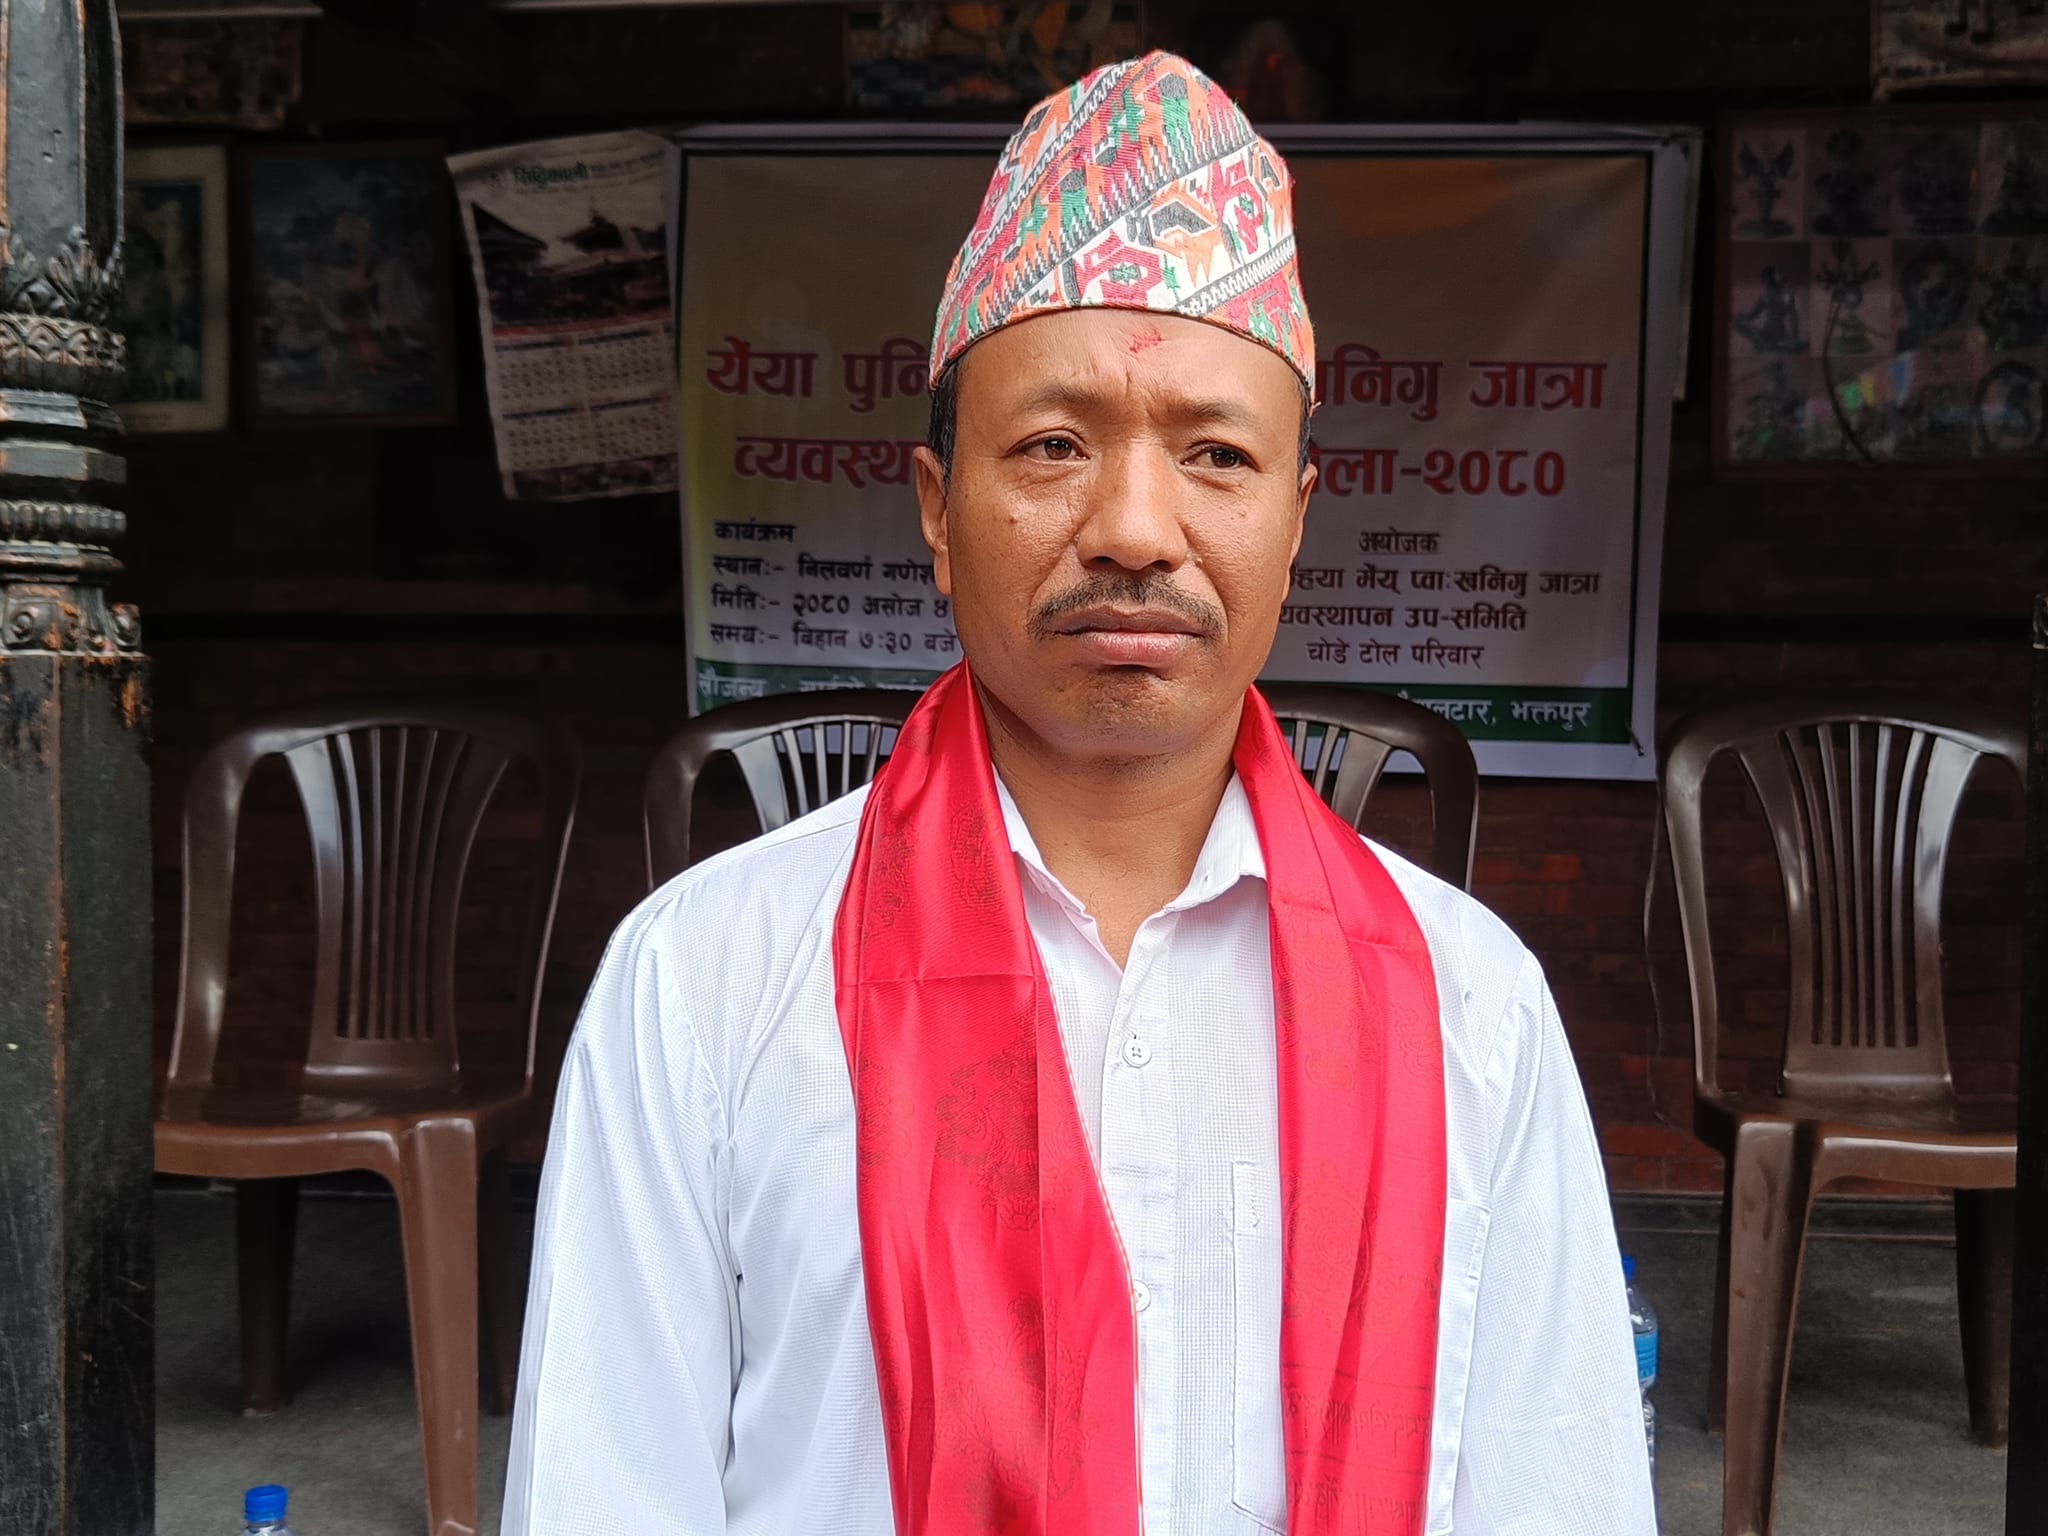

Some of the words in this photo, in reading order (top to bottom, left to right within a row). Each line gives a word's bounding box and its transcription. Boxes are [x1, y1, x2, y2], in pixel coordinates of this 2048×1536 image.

[1470, 362, 1608, 411] जात्रा
[735, 437, 928, 488] व्यवस्थ
[1539, 571, 1603, 595] जात्रा
[793, 594, 850, 617] २०८०
[863, 593, 923, 617] असोज
[934, 599, 949, 618] ४
[1279, 604, 1395, 628] यवस्थापन
[1405, 602, 1528, 632] उप-समिति
[860, 632, 913, 654] ७:३०
[1307, 638, 1350, 665] चोडे
[1359, 638, 1401, 666] टोल
[1411, 637, 1485, 668] परिवार
[1510, 699, 1592, 731] भक्तपुर
